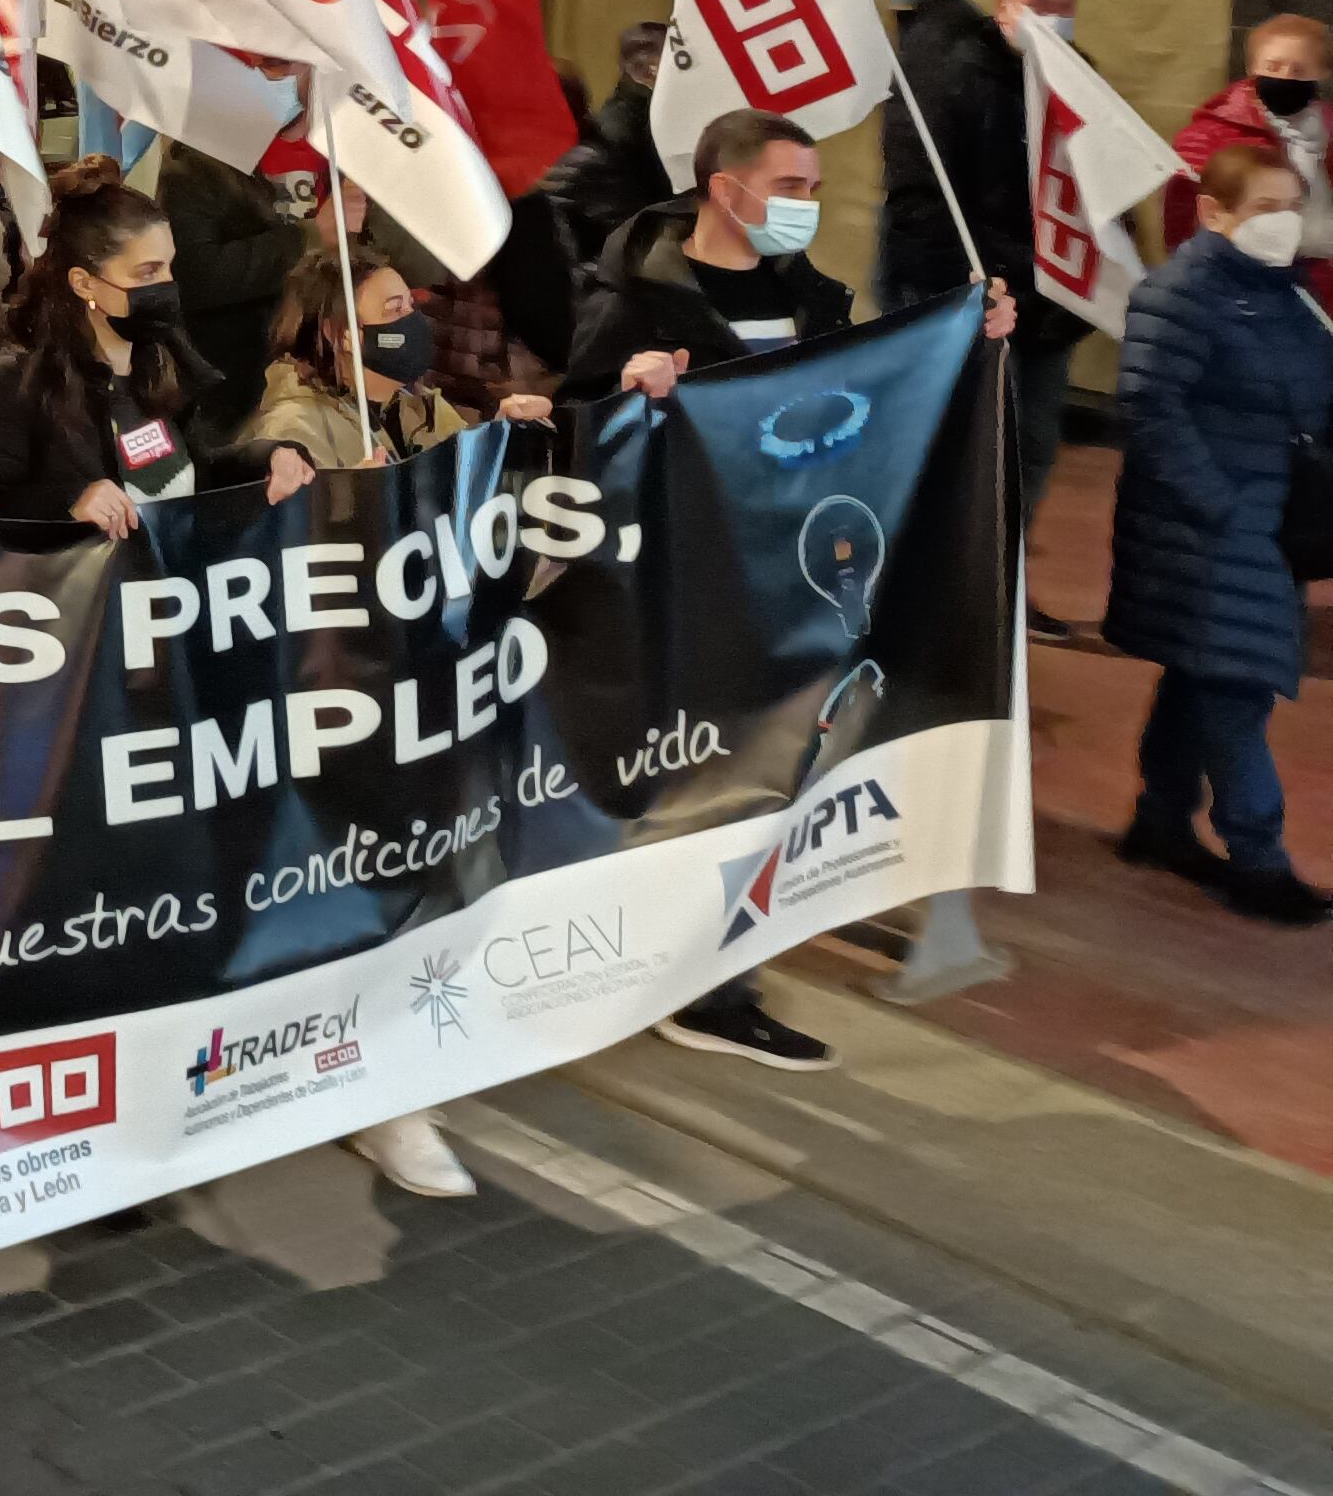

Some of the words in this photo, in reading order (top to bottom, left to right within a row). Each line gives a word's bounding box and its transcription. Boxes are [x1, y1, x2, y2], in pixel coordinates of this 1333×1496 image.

[121, 474, 643, 671] PRECIOS,
[100, 616, 549, 827] EMPLEO
[244, 792, 503, 914] condiciones
[516, 744, 580, 809] de
[615, 708, 731, 788] vida
[785, 778, 902, 864] UPTA
[483, 905, 623, 987] CEAV
[317, 1045, 359, 1069] CCOO
[15, 1188, 27, 1214] y
[29, 1171, 82, 1203] León
[16, 1138, 93, 1177] obreras
